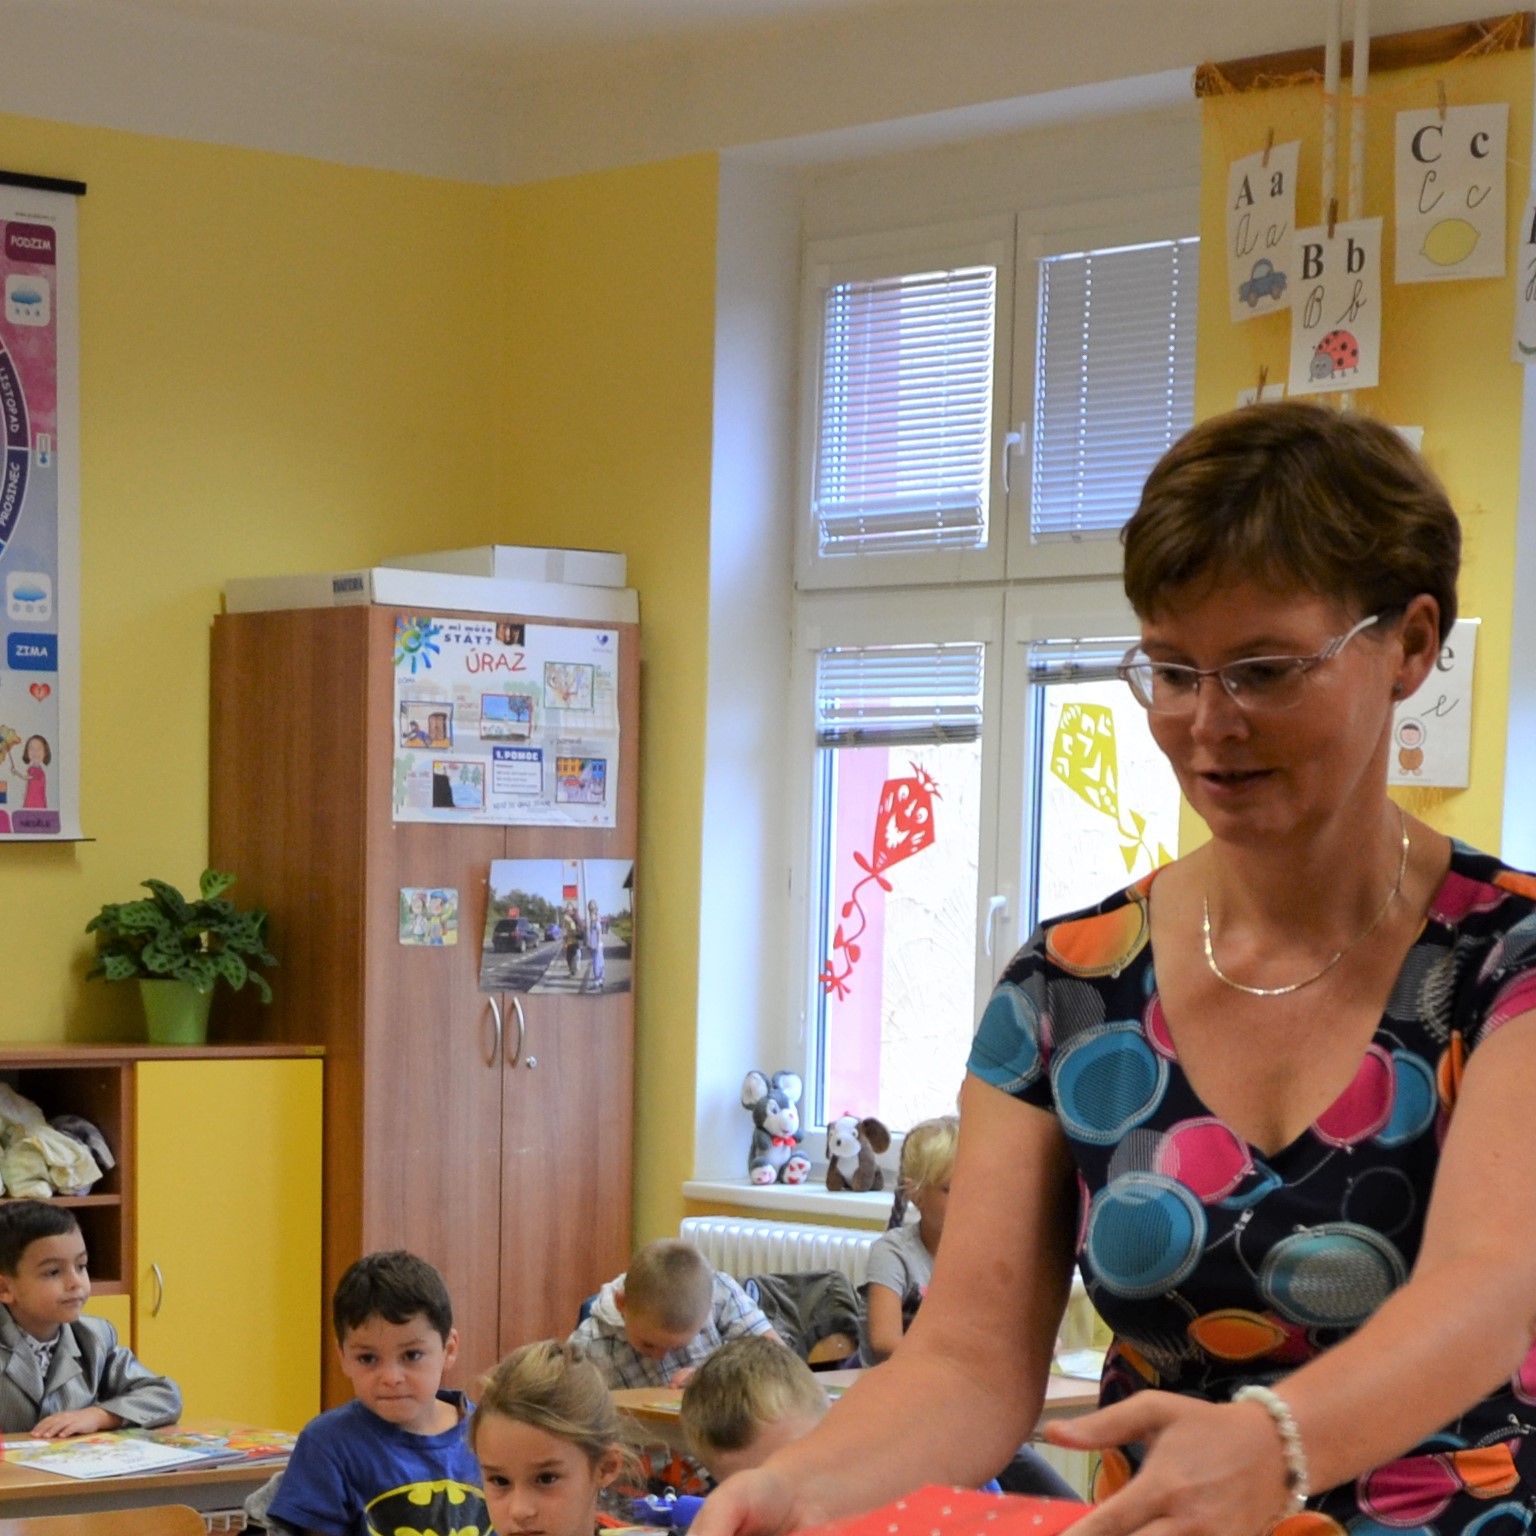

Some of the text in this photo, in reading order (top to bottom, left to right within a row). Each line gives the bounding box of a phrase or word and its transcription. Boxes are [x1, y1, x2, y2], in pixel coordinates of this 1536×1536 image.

[1411, 125, 1489, 163] C c
[1234, 171, 1284, 210] A a
[10, 235, 52, 252] PODZIM
[1301, 238, 1366, 280] B b
[15, 644, 49, 659] ZIMA
[444, 632, 494, 646] STÁT?
[464, 648, 527, 675] ÚRAZ
